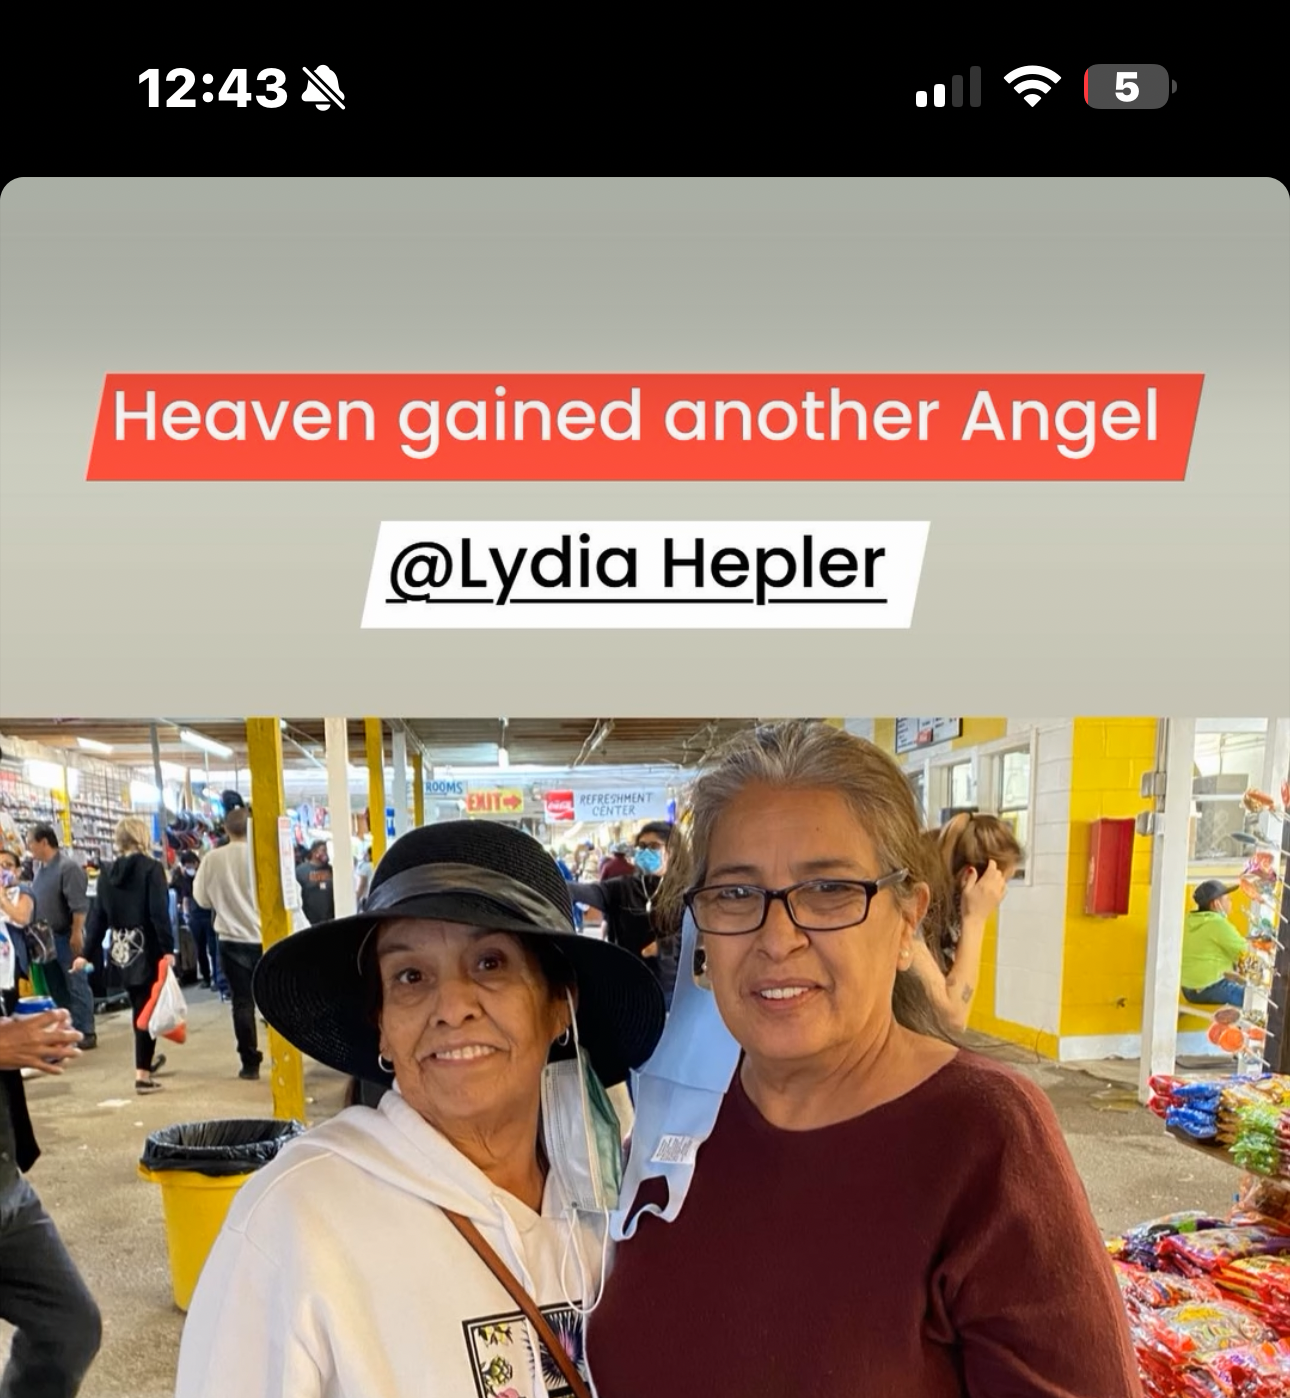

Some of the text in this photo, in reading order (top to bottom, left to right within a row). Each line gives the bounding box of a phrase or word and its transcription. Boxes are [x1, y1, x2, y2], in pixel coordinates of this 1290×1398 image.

[425, 780, 463, 795] ROOMS
[467, 792, 501, 812] EXIT
[580, 793, 653, 804] REFRESHMENT
[592, 805, 635, 816] CENTER
